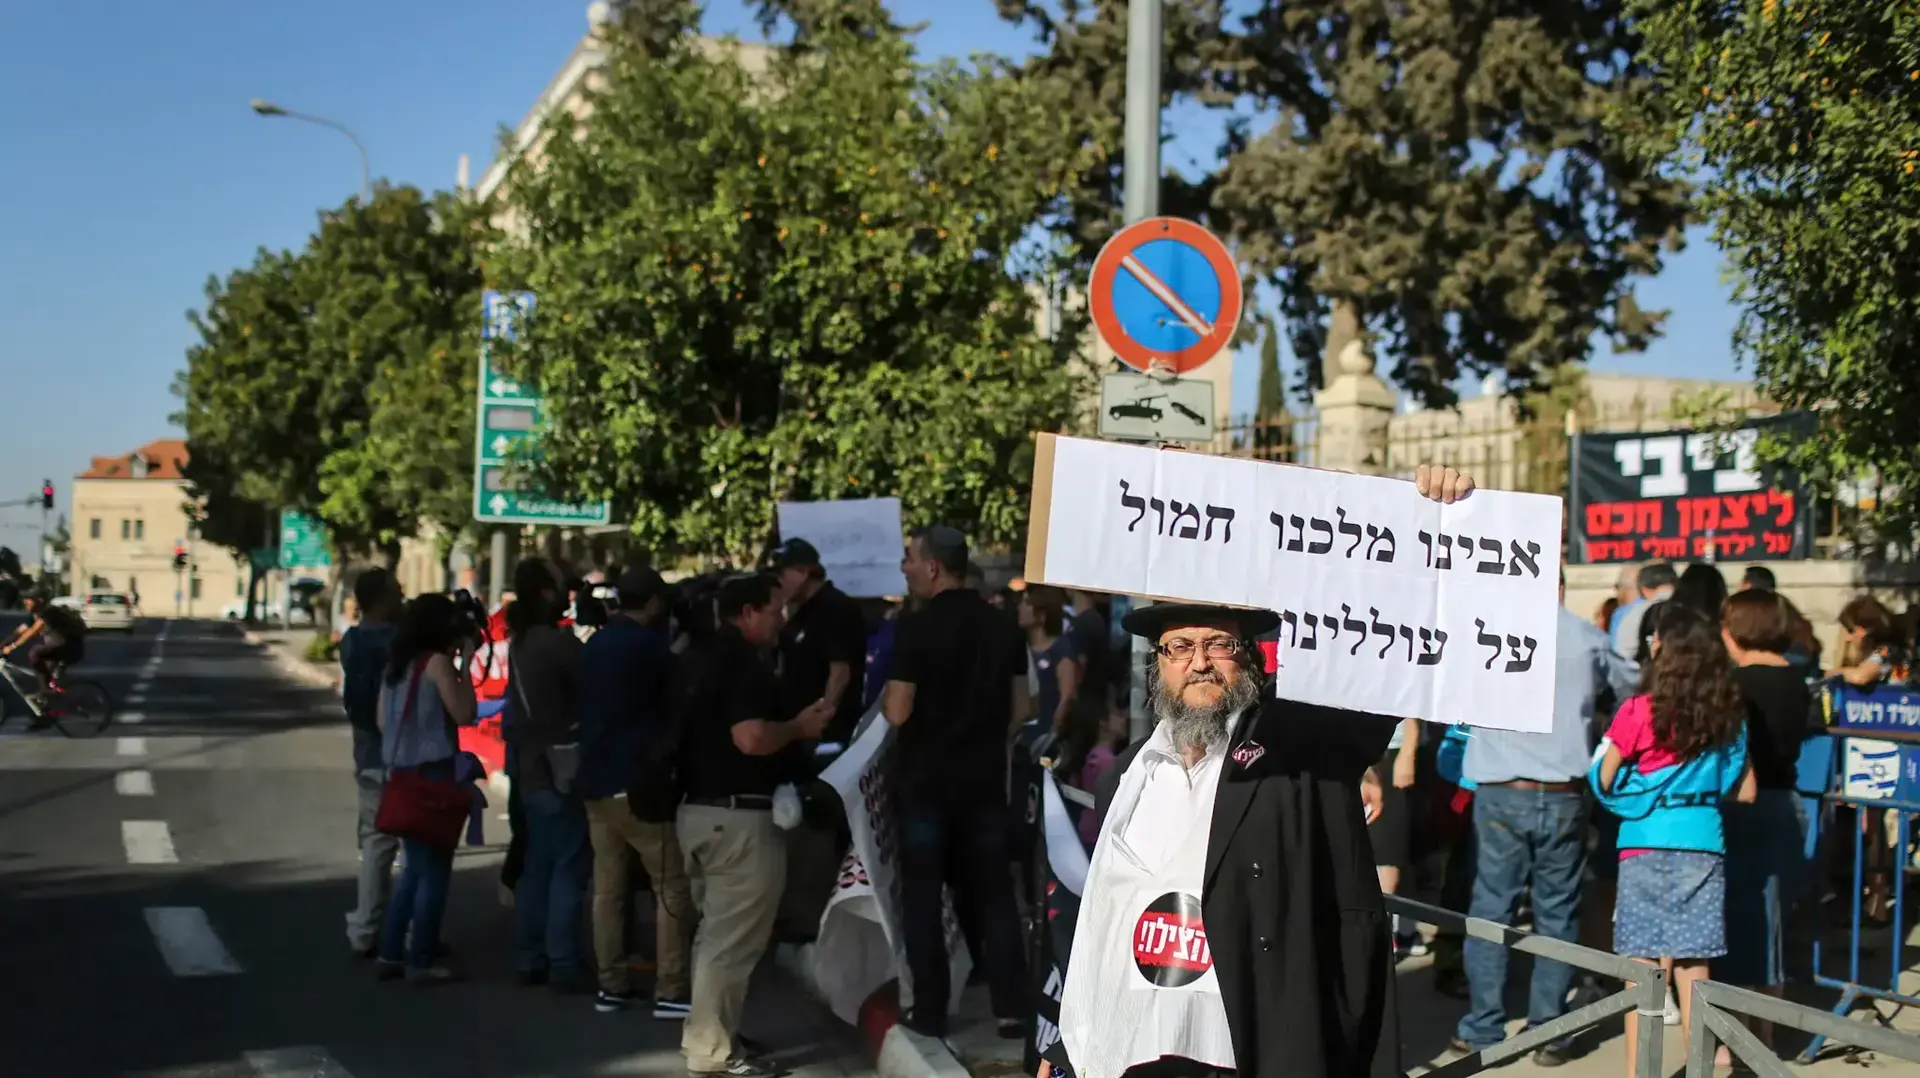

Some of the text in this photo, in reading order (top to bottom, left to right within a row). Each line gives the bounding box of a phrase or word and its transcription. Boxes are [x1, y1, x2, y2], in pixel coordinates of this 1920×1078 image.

[1614, 428, 1762, 498] ביבי
[1119, 478, 1541, 579] אבינו מלכנו חמול
[1586, 487, 1794, 538] ליצמן חכם
[1762, 531, 1792, 554] על
[1284, 602, 1538, 673] על עוללינו
[1138, 917, 1211, 964] הצילו!
